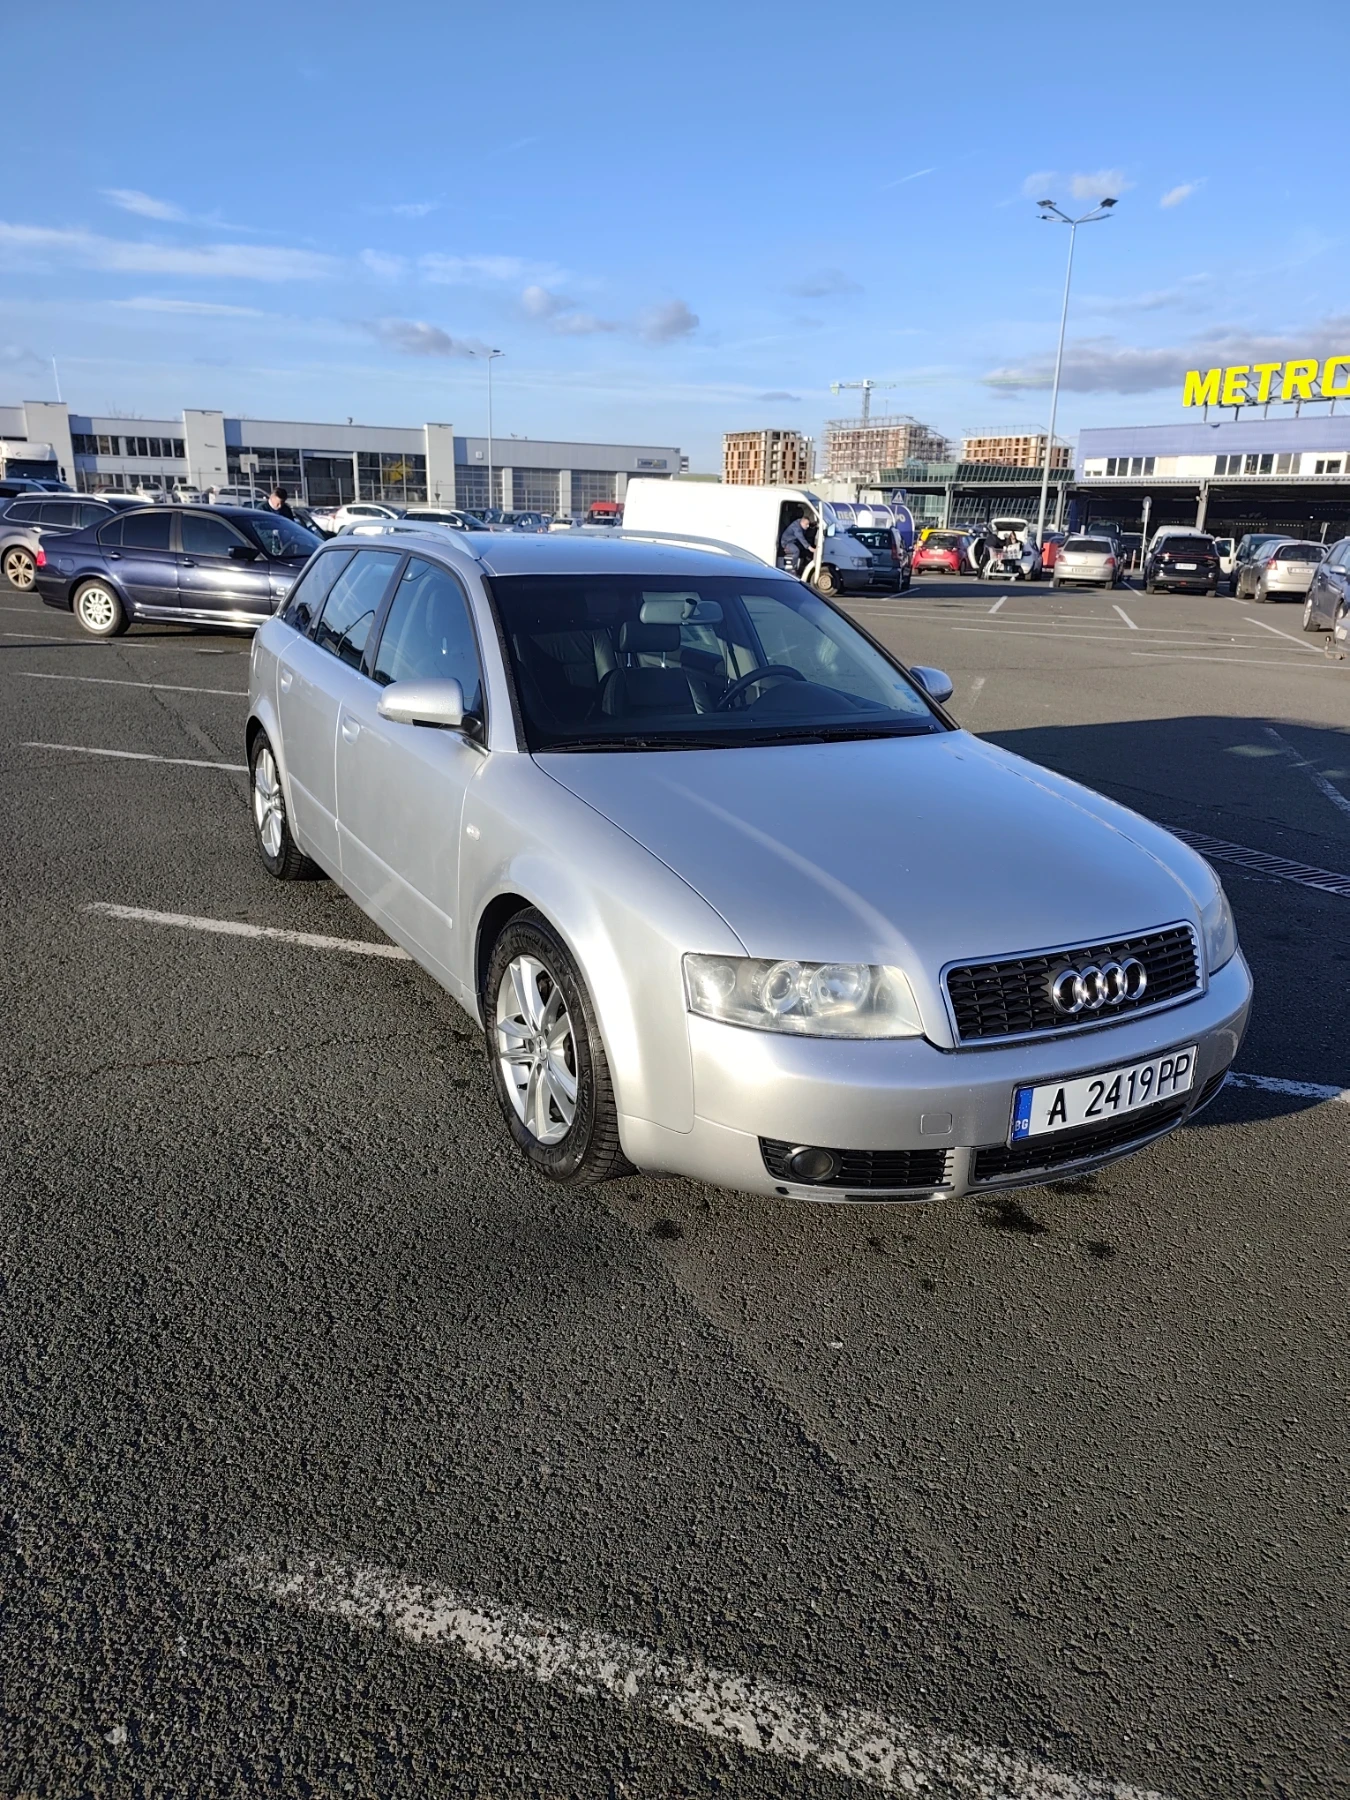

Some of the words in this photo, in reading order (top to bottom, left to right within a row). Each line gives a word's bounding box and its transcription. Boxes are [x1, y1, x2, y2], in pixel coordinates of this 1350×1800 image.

[1182, 355, 1350, 407] METRO
[1014, 1117, 1029, 1132] BG
[1047, 1088, 1067, 1126] A
